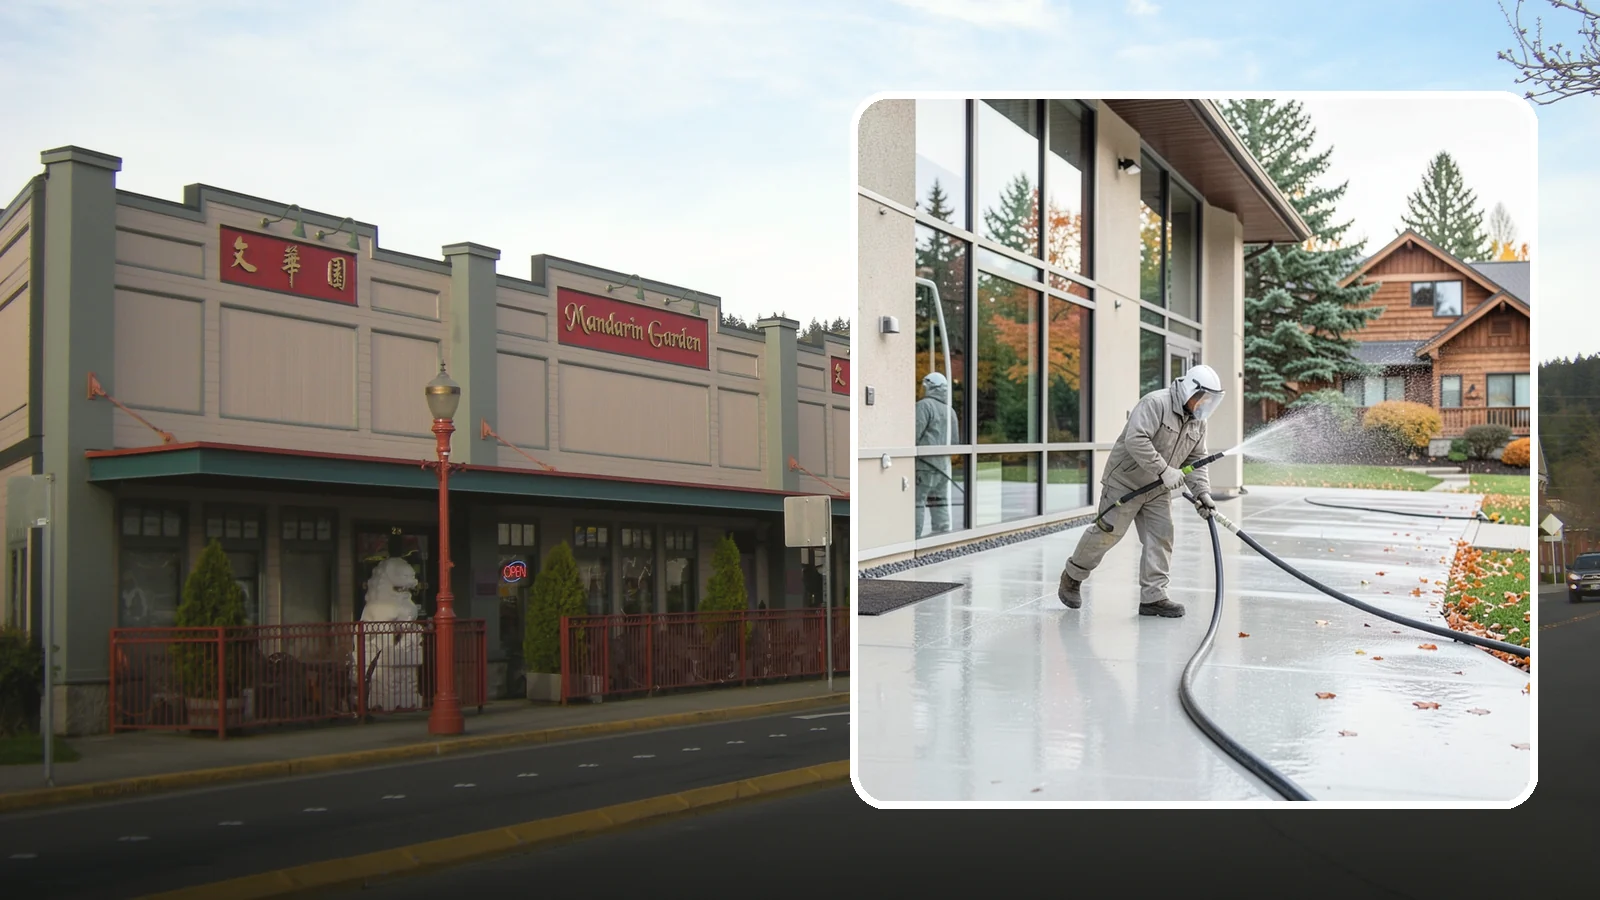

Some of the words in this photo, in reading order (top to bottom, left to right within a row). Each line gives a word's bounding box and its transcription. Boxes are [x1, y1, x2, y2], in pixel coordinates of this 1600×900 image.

[231, 235, 346, 291] 文華園
[564, 302, 644, 341] Mandarin
[648, 320, 701, 352] Garden
[503, 565, 527, 578] OPEN
